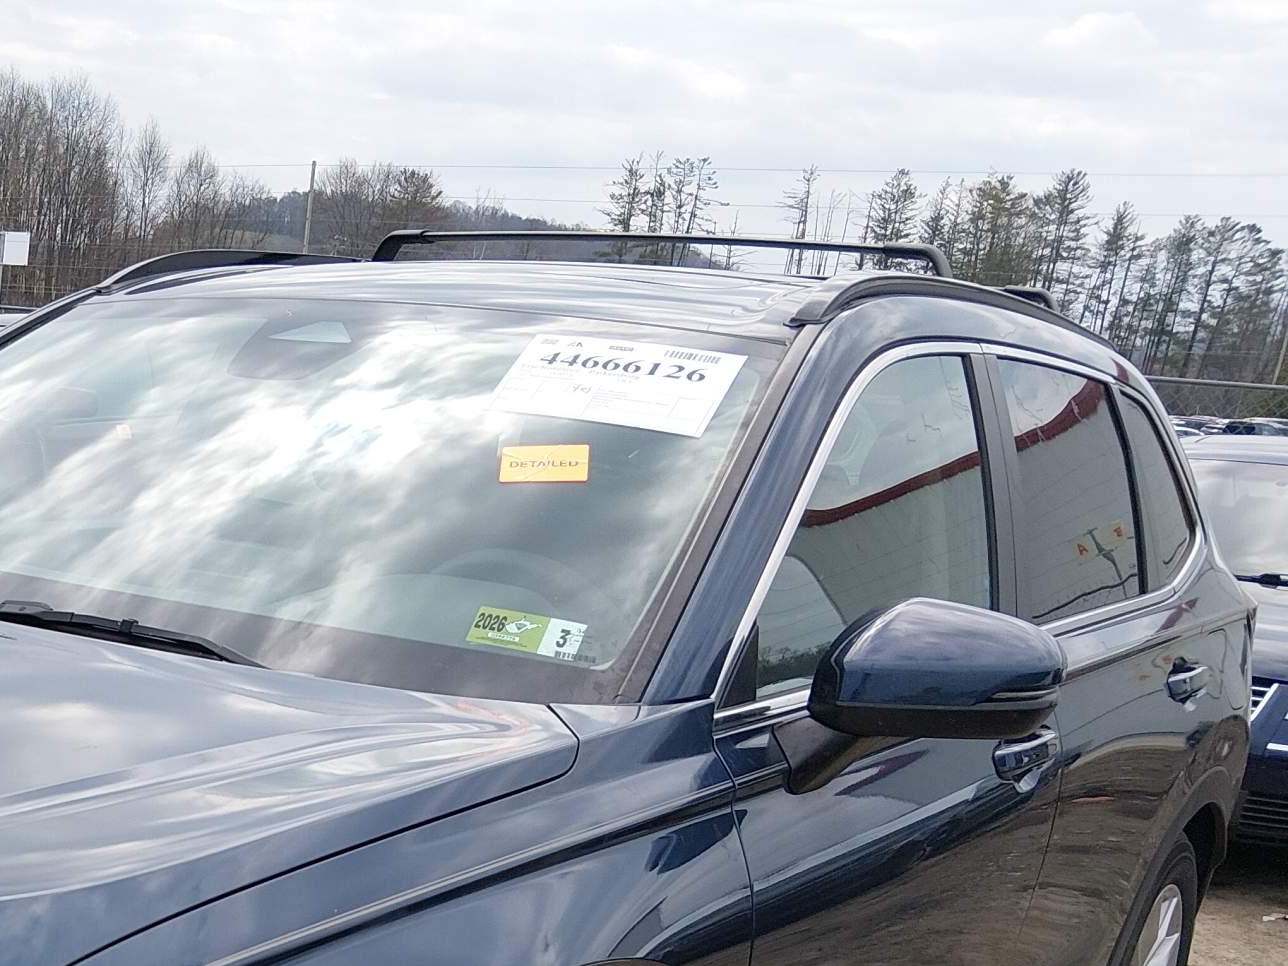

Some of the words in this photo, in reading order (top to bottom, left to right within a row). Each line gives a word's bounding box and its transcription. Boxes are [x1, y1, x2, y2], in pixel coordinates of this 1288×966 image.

[539, 351, 707, 383] 44666126
[509, 459, 579, 468] DETAILED
[474, 612, 508, 632] 2026
[555, 629, 571, 648] 3
